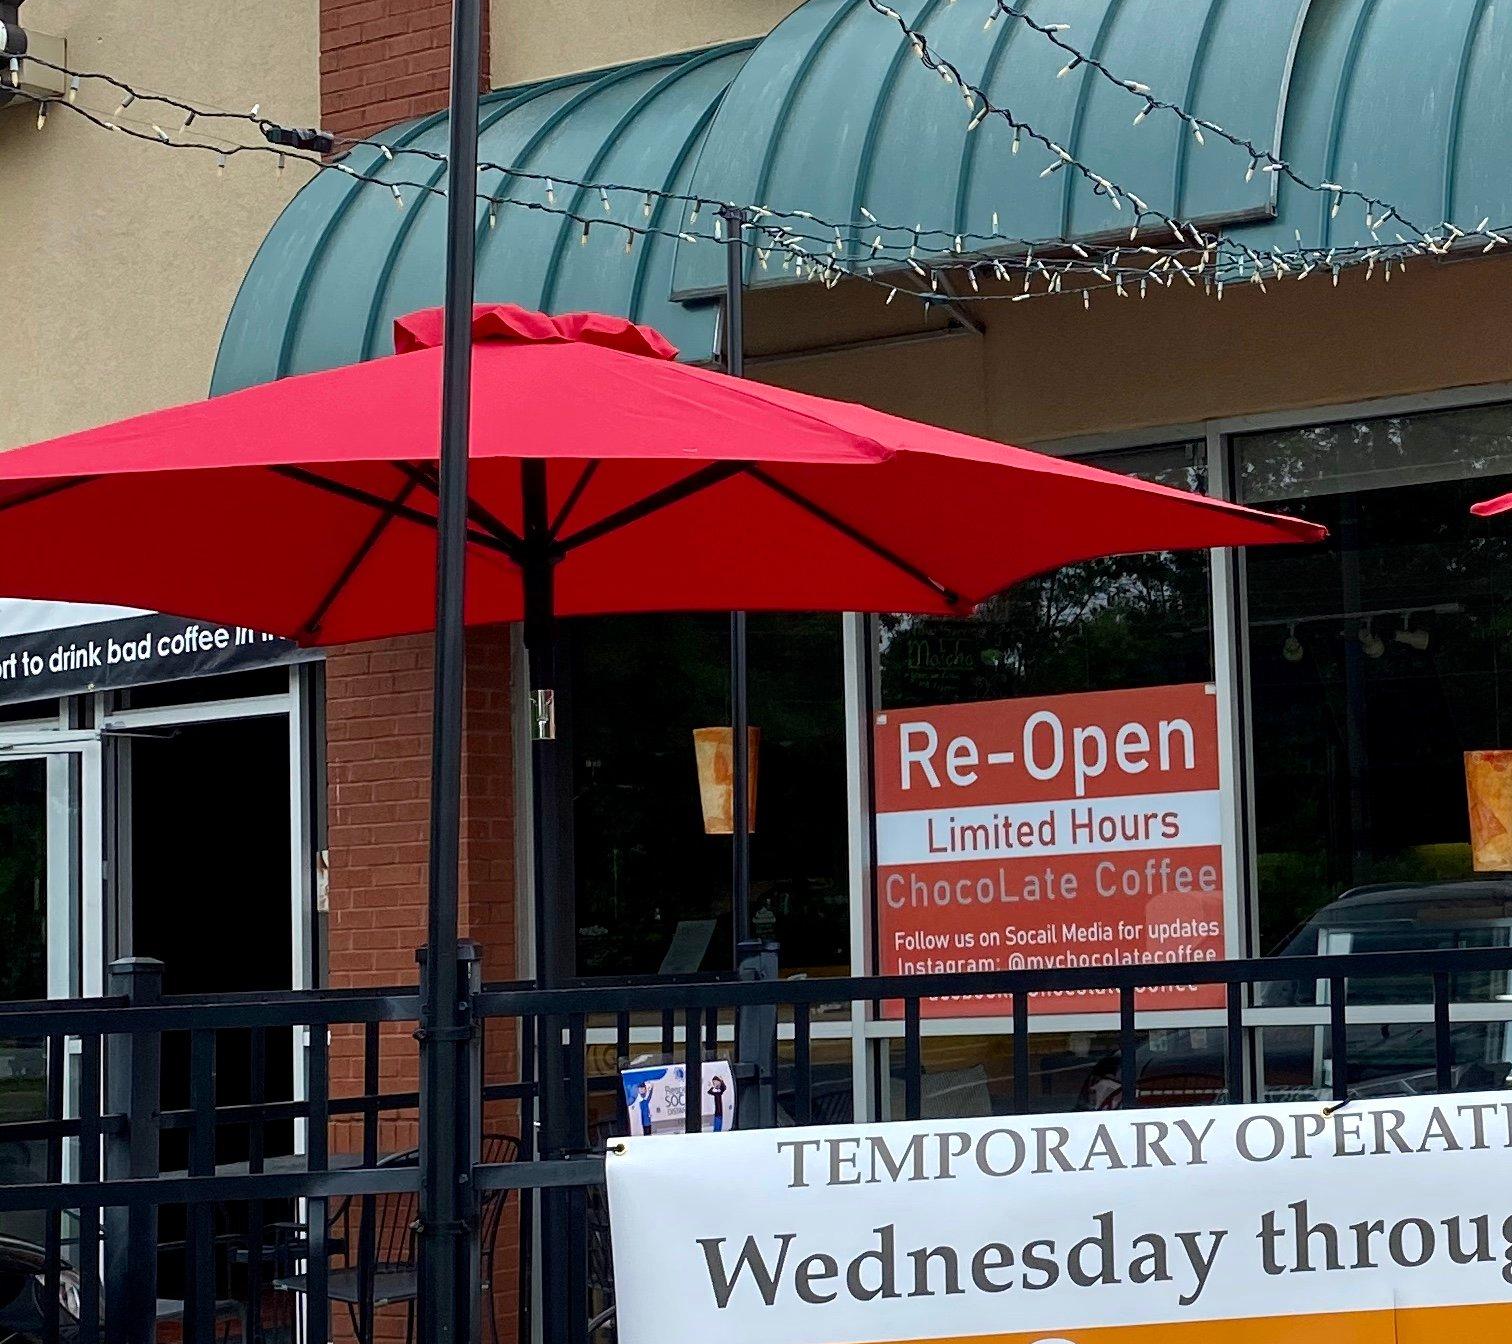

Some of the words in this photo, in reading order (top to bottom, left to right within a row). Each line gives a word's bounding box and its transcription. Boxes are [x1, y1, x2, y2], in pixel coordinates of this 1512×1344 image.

[21, 651, 44, 677] to
[48, 641, 102, 673] drink
[107, 632, 151, 665] bad
[157, 625, 229, 657] coffee
[899, 710, 1196, 798] Re-Open
[927, 809, 1057, 854] Limited
[1070, 806, 1181, 846] Hours
[885, 868, 1079, 910] ChocoLate
[1095, 857, 1218, 897] Coffee
[894, 931, 950, 951] Follow
[954, 932, 975, 948] us
[979, 931, 1001, 947] on
[1005, 923, 1058, 946] Socail
[1062, 921, 1113, 943] Media
[1118, 920, 1144, 940] for
[1148, 918, 1220, 943] updates
[776, 1117, 1217, 1189] TEMPORARY
[696, 1210, 1229, 1310] Wednesday
